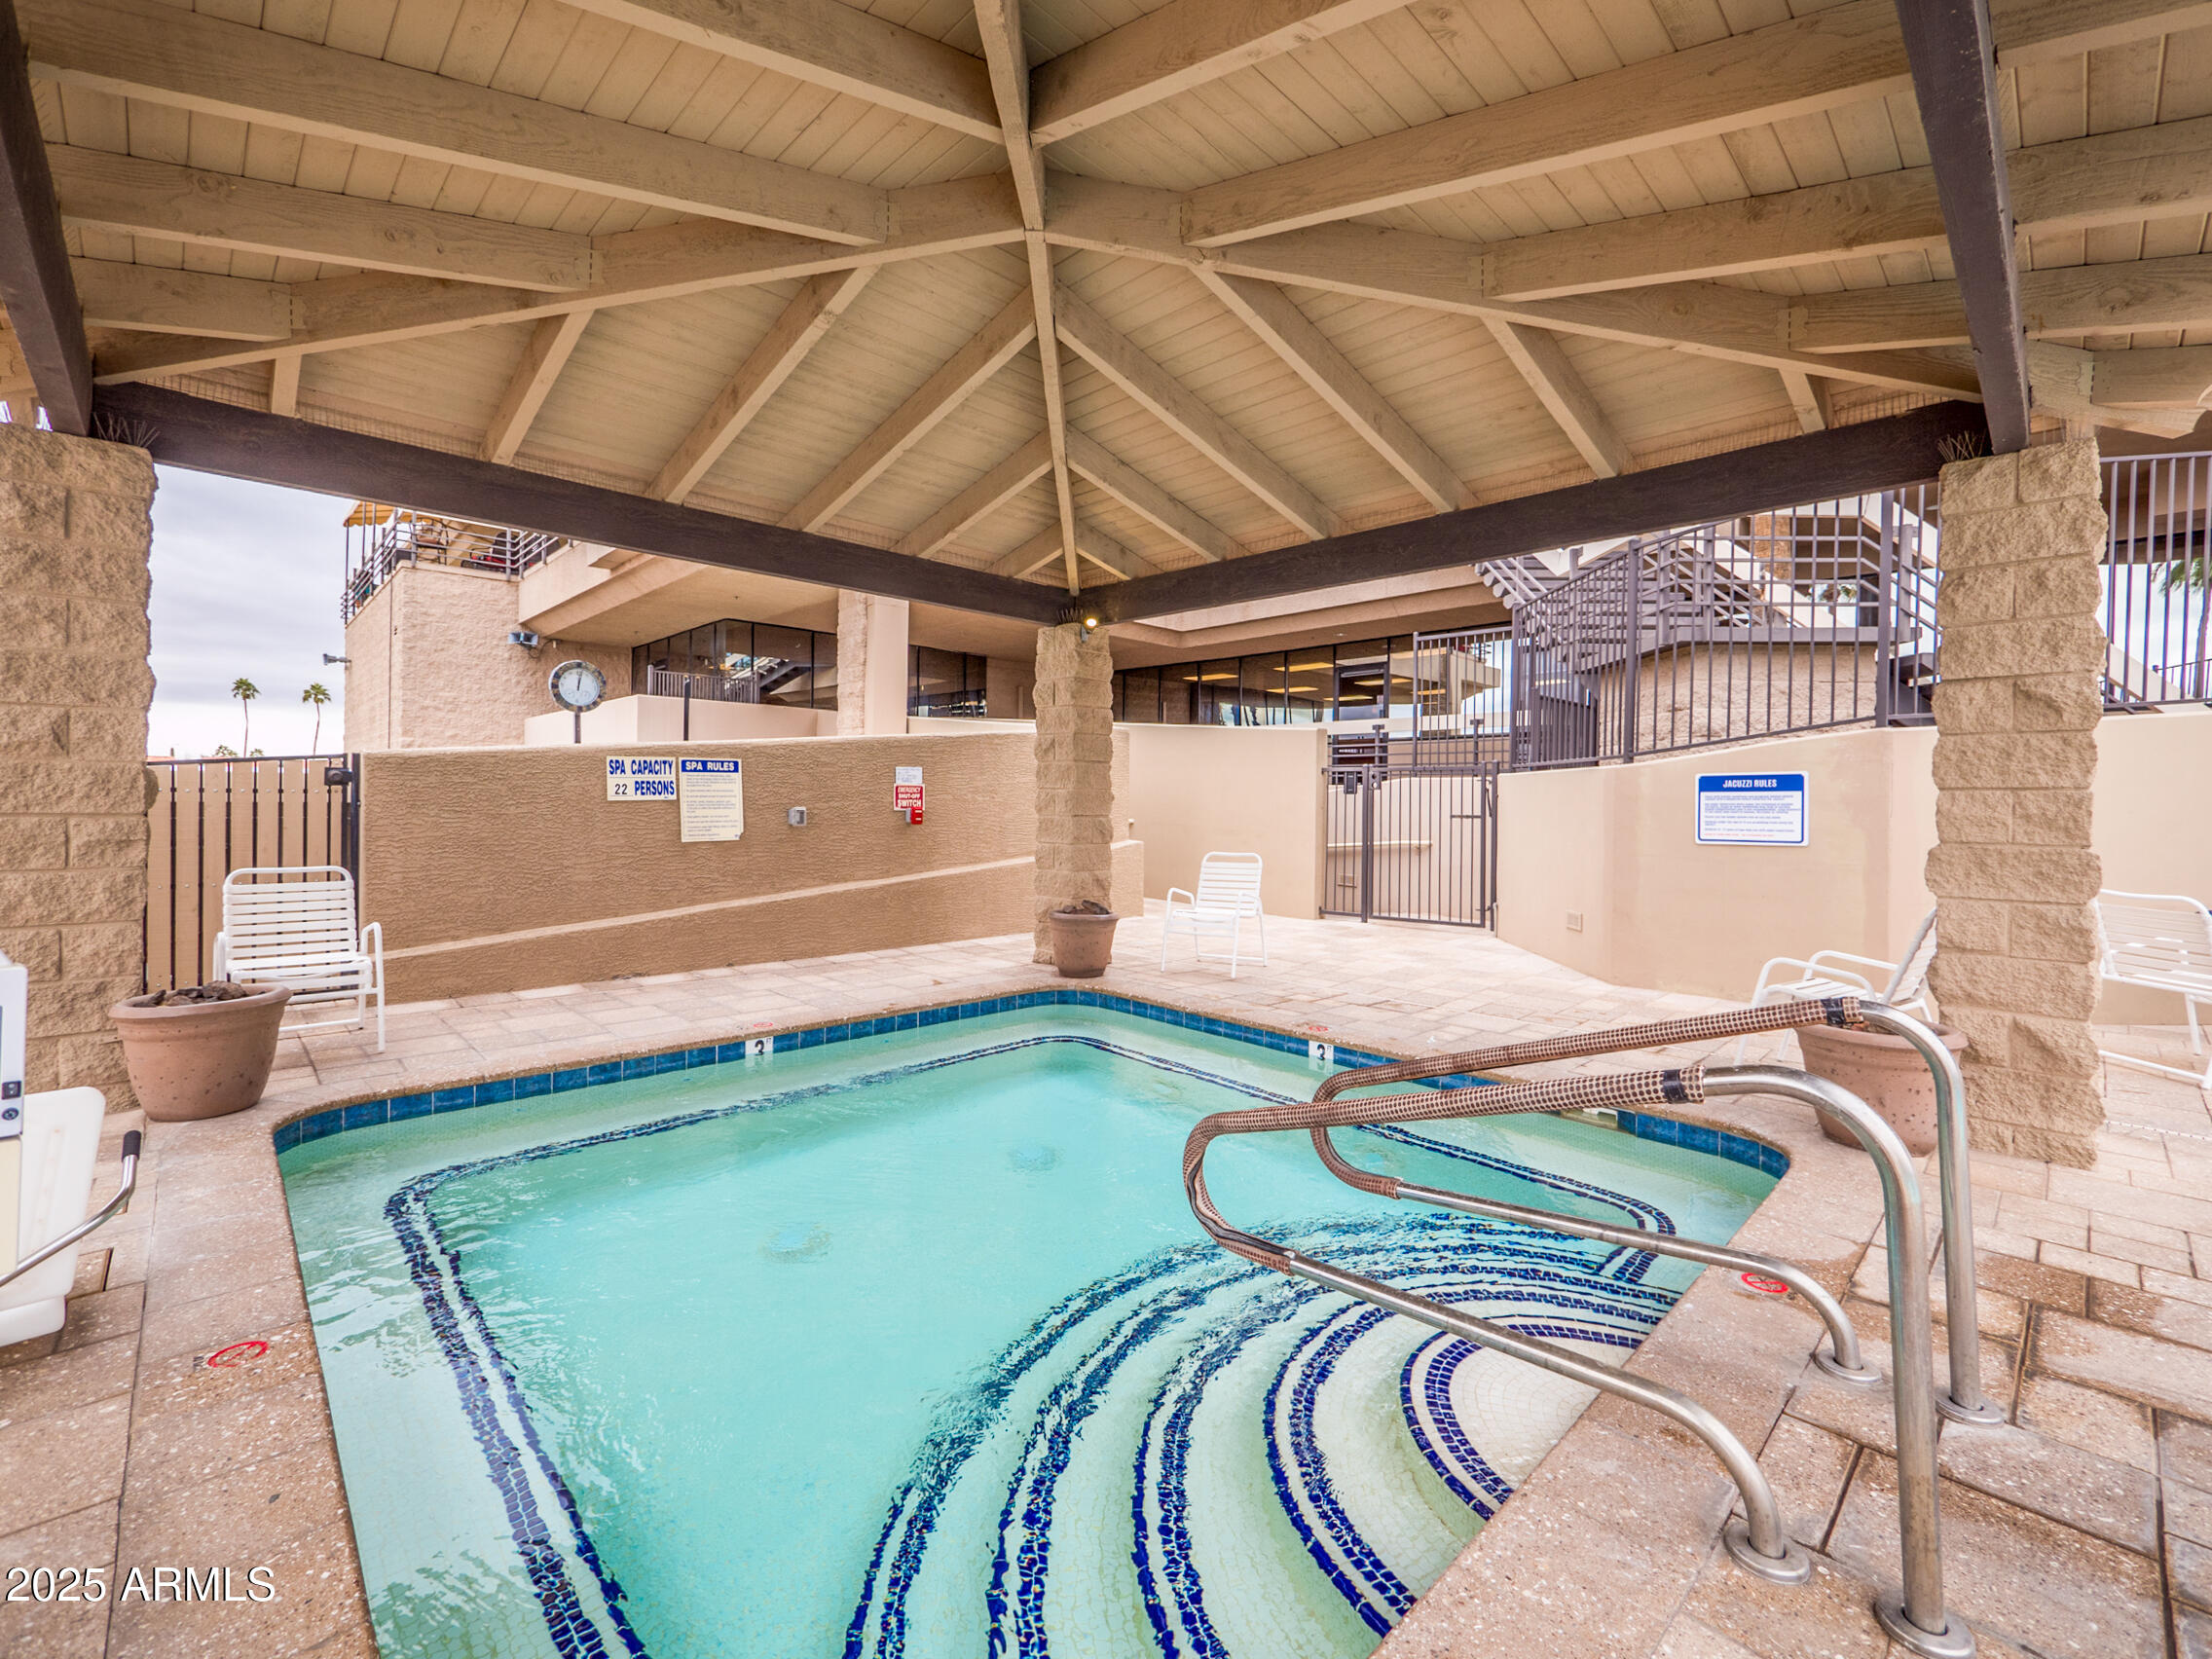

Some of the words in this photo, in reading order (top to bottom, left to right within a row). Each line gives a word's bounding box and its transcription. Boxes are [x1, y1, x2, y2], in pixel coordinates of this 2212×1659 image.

[608, 759, 626, 775] SPA
[631, 759, 674, 776] CAPACITY
[685, 761, 703, 771] SPA
[707, 762, 735, 772] RULES
[614, 783, 628, 795] 22
[635, 780, 675, 796] PERSONS
[1722, 779, 1752, 789] JACUZZI
[1753, 779, 1778, 789] RULES
[897, 799, 922, 808] SWITCH
